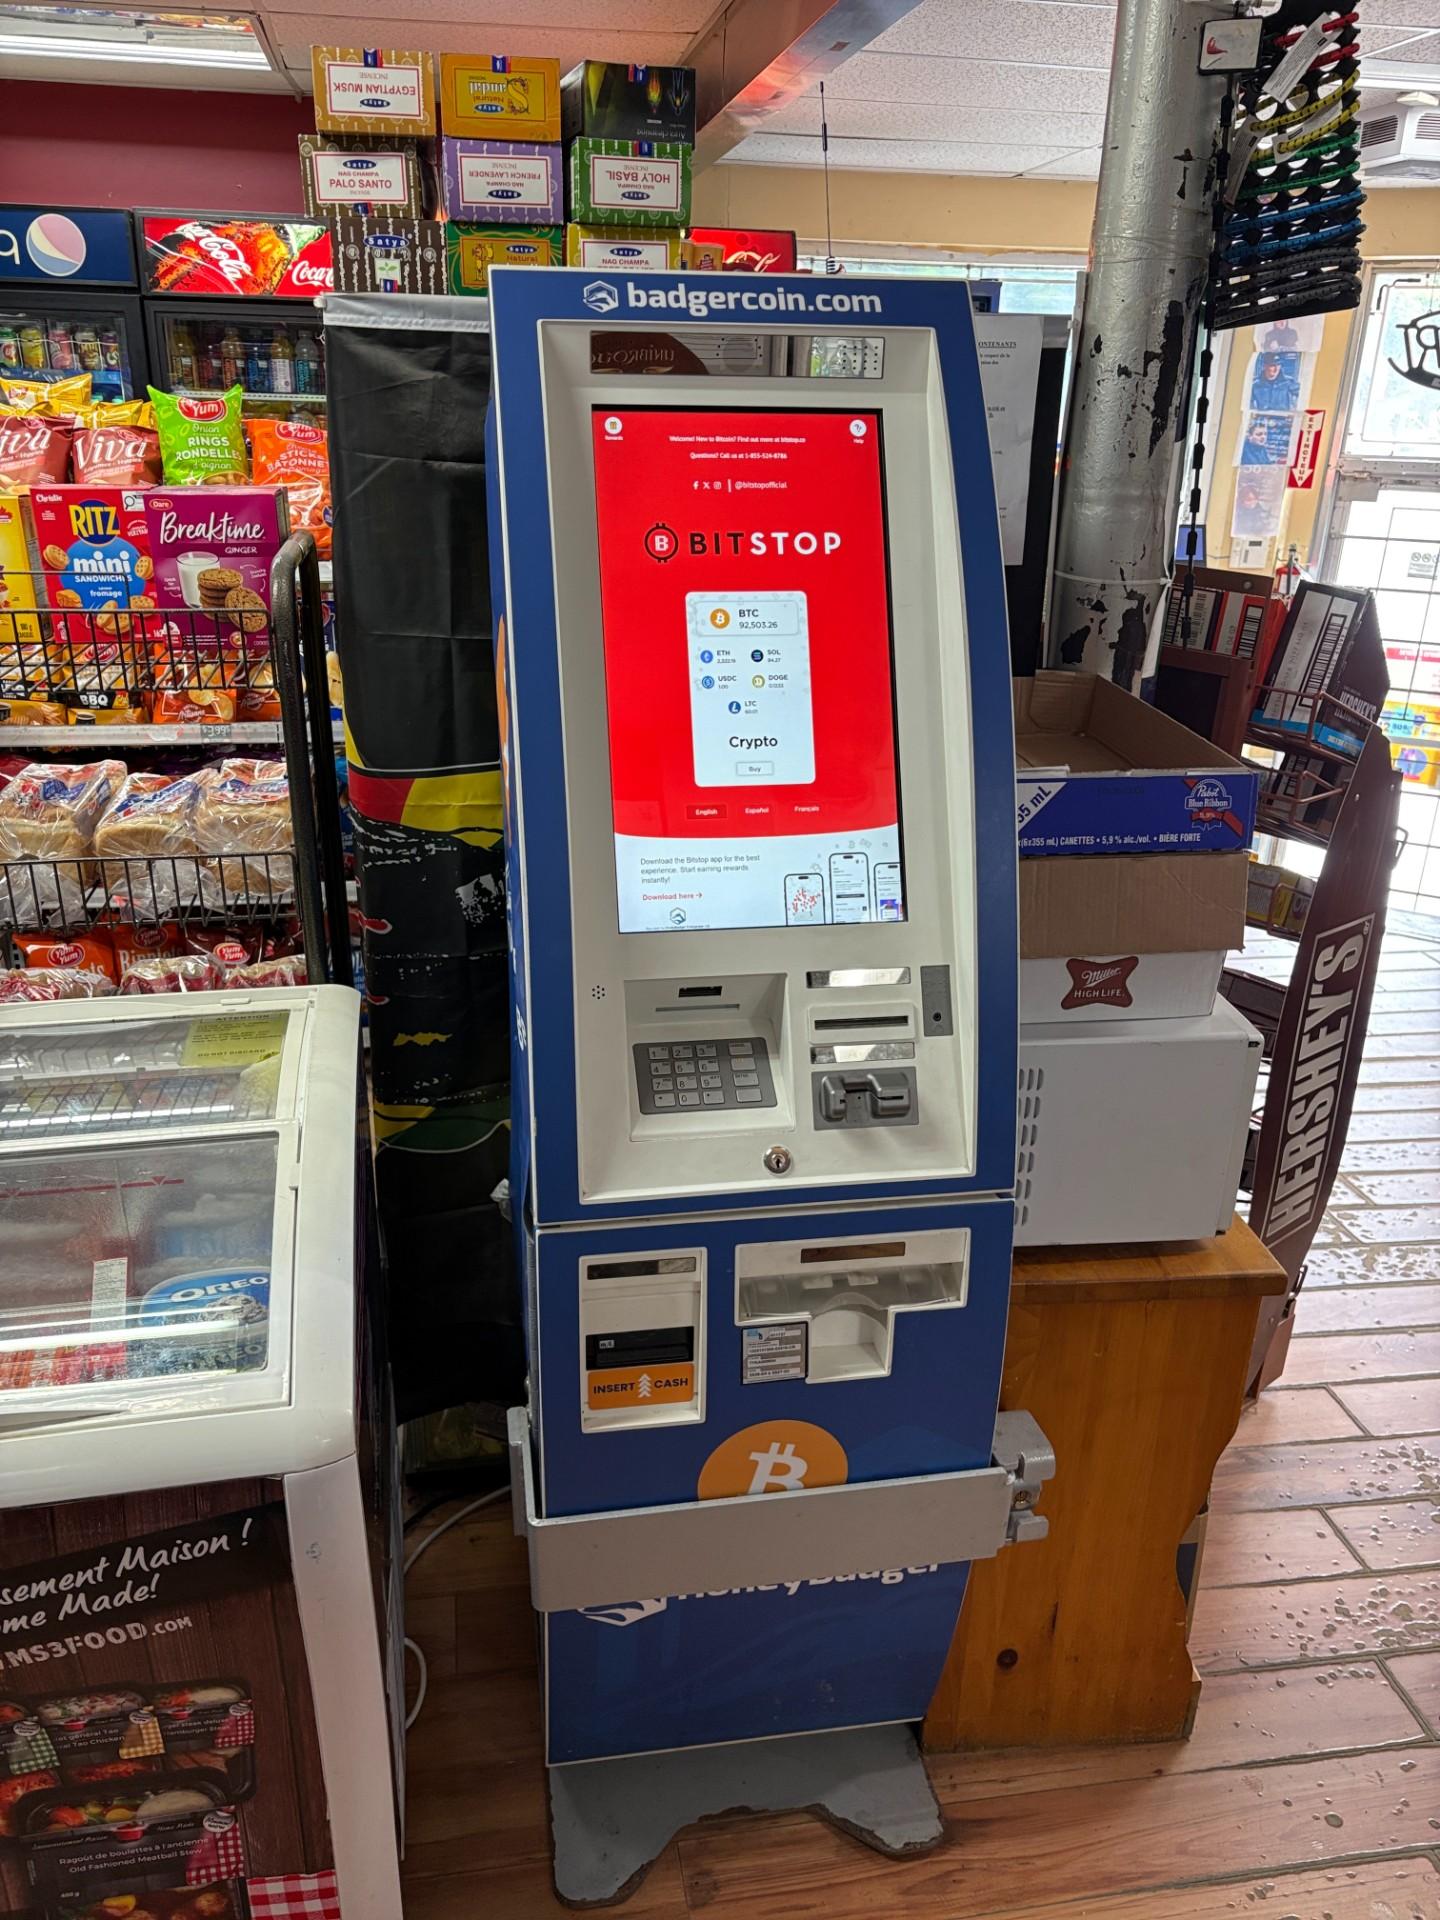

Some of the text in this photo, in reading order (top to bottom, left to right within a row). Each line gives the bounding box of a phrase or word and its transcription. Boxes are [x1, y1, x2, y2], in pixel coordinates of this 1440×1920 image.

[333, 82, 416, 96] EGYPTIAN MUSK
[469, 170, 541, 180] FRENCH LAVENDER
[606, 171, 670, 183] HOLY BASIL
[329, 179, 392, 189] PALO SANTO
[368, 237, 406, 247] Satya
[507, 255, 538, 263] Natural
[627, 282, 882, 317] badgercoin.com
[192, 401, 218, 416] Yum
[0, 427, 52, 457] iva
[188, 436, 230, 447] RINGS
[73, 428, 147, 470] Viva
[1297, 416, 1314, 482] EXTINCTEUR
[735, 481, 787, 490] @bitstopofficial
[69, 504, 120, 537] RITZ
[160, 512, 265, 545] Breaktime
[225, 546, 258, 554] GINGER
[689, 532, 842, 556] BITSTOP
[73, 550, 131, 574] mini
[90, 590, 122, 598] fromage
[738, 609, 759, 618] BTC
[739, 621, 778, 630] 92,503.26
[80, 694, 109, 707] BBQ
[729, 736, 778, 750] Crypto
[745, 806, 769, 815] Español
[1204, 799, 1228, 808] Ribbon
[695, 808, 718, 818] English
[1060, 836, 1095, 846] CANETTES
[1102, 835, 1114, 844] 5,9
[1159, 832, 1179, 843] BIÈRE
[1179, 832, 1201, 843] FORTE
[640, 857, 673, 865] Download
[686, 856, 709, 864] Bitstop
[642, 893, 677, 901] Download
[1082, 967, 1122, 988] Miller
[1074, 988, 1122, 999] HIGH LIFE
[1266, 930, 1368, 1239] HERSHEY'S
[170, 1276, 269, 1304] OREO
[593, 1377, 688, 1394] INSERT CASH
[116, 1540, 230, 1578] Maison
[58, 1573, 160, 1621] Made!
[69, 1864, 87, 1873] Old
[88, 1859, 137, 1871] Fashioned
[137, 1851, 178, 1863] Meatball
